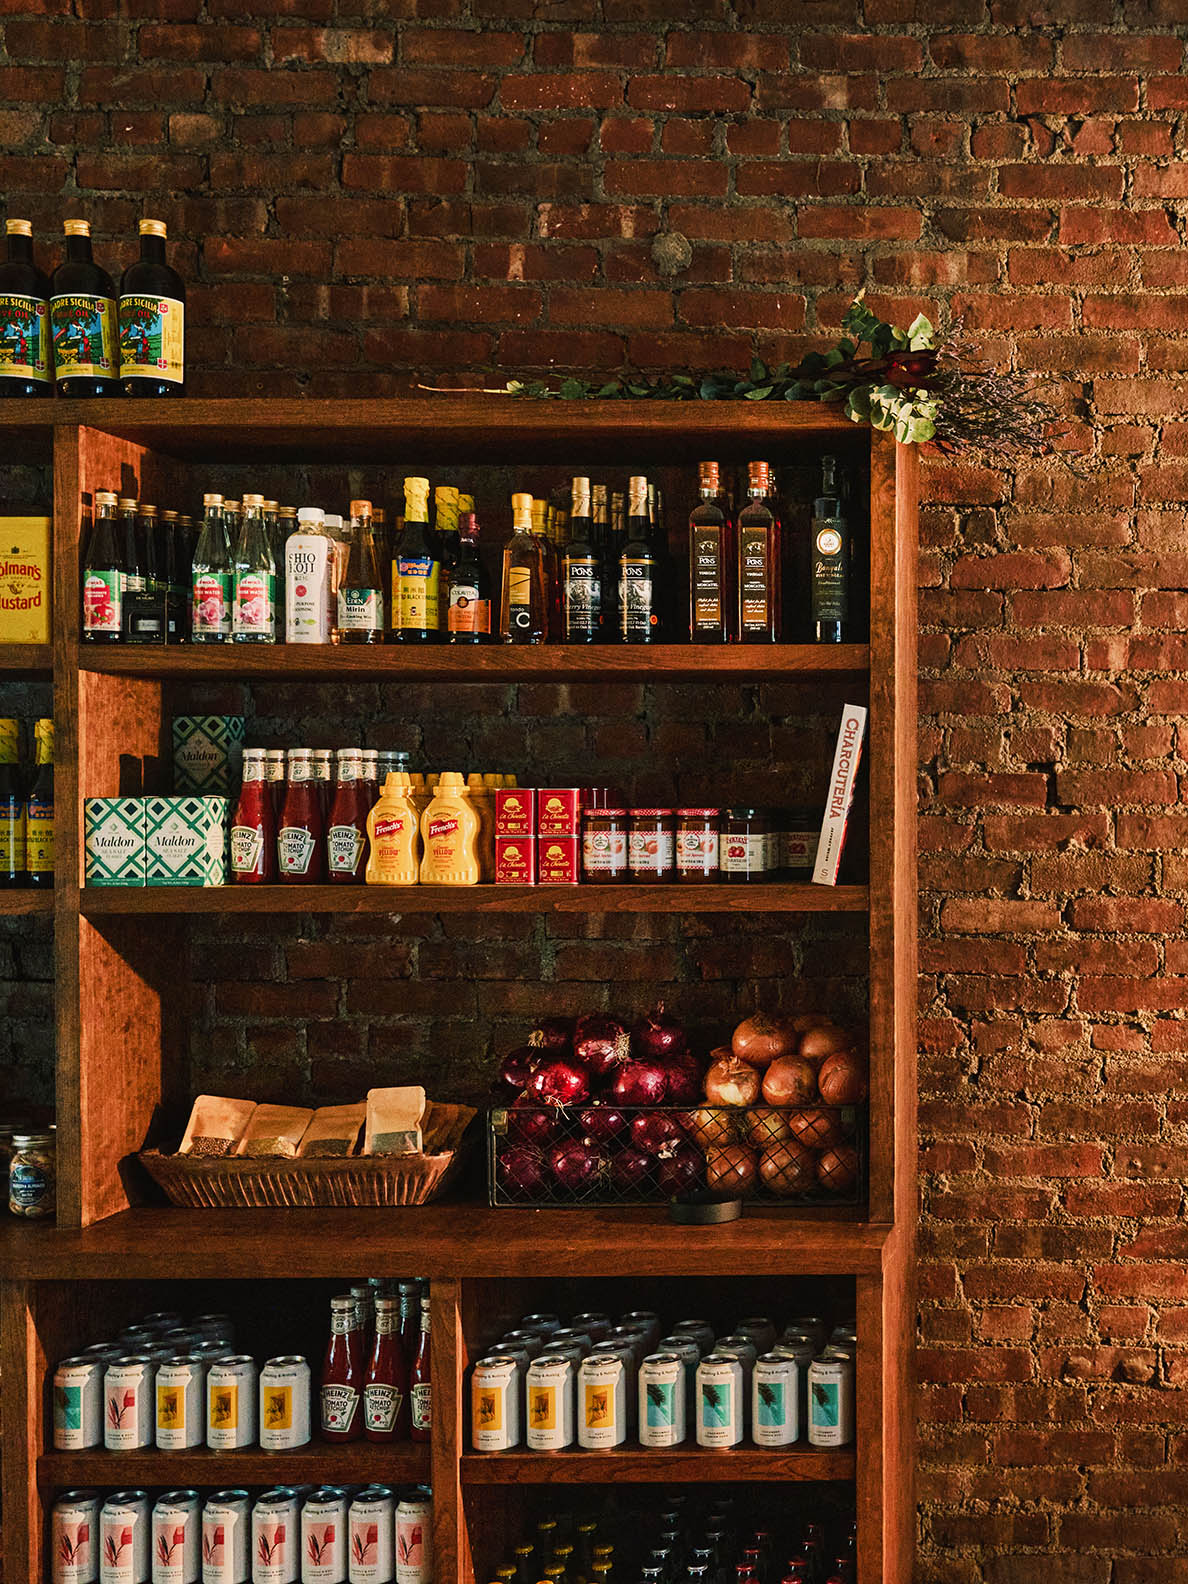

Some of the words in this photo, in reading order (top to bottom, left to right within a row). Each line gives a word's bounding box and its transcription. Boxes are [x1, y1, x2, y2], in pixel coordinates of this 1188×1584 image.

[70, 297, 96, 313] SICILIA
[134, 297, 159, 313] SICILIA
[746, 558, 763, 566] PONS
[571, 567, 593, 576] PONS
[622, 567, 643, 576] PONS
[182, 752, 218, 761] Maldon
[829, 717, 860, 820] CHARCUTERÍA
[376, 822, 403, 835] French's
[430, 822, 457, 835] French's
[332, 831, 355, 839] HEINZ
[94, 837, 135, 847] Maldon
[154, 835, 195, 847] Maldon
[325, 1389, 349, 1399] HEINZ
[369, 1389, 392, 1398] HEINZ
